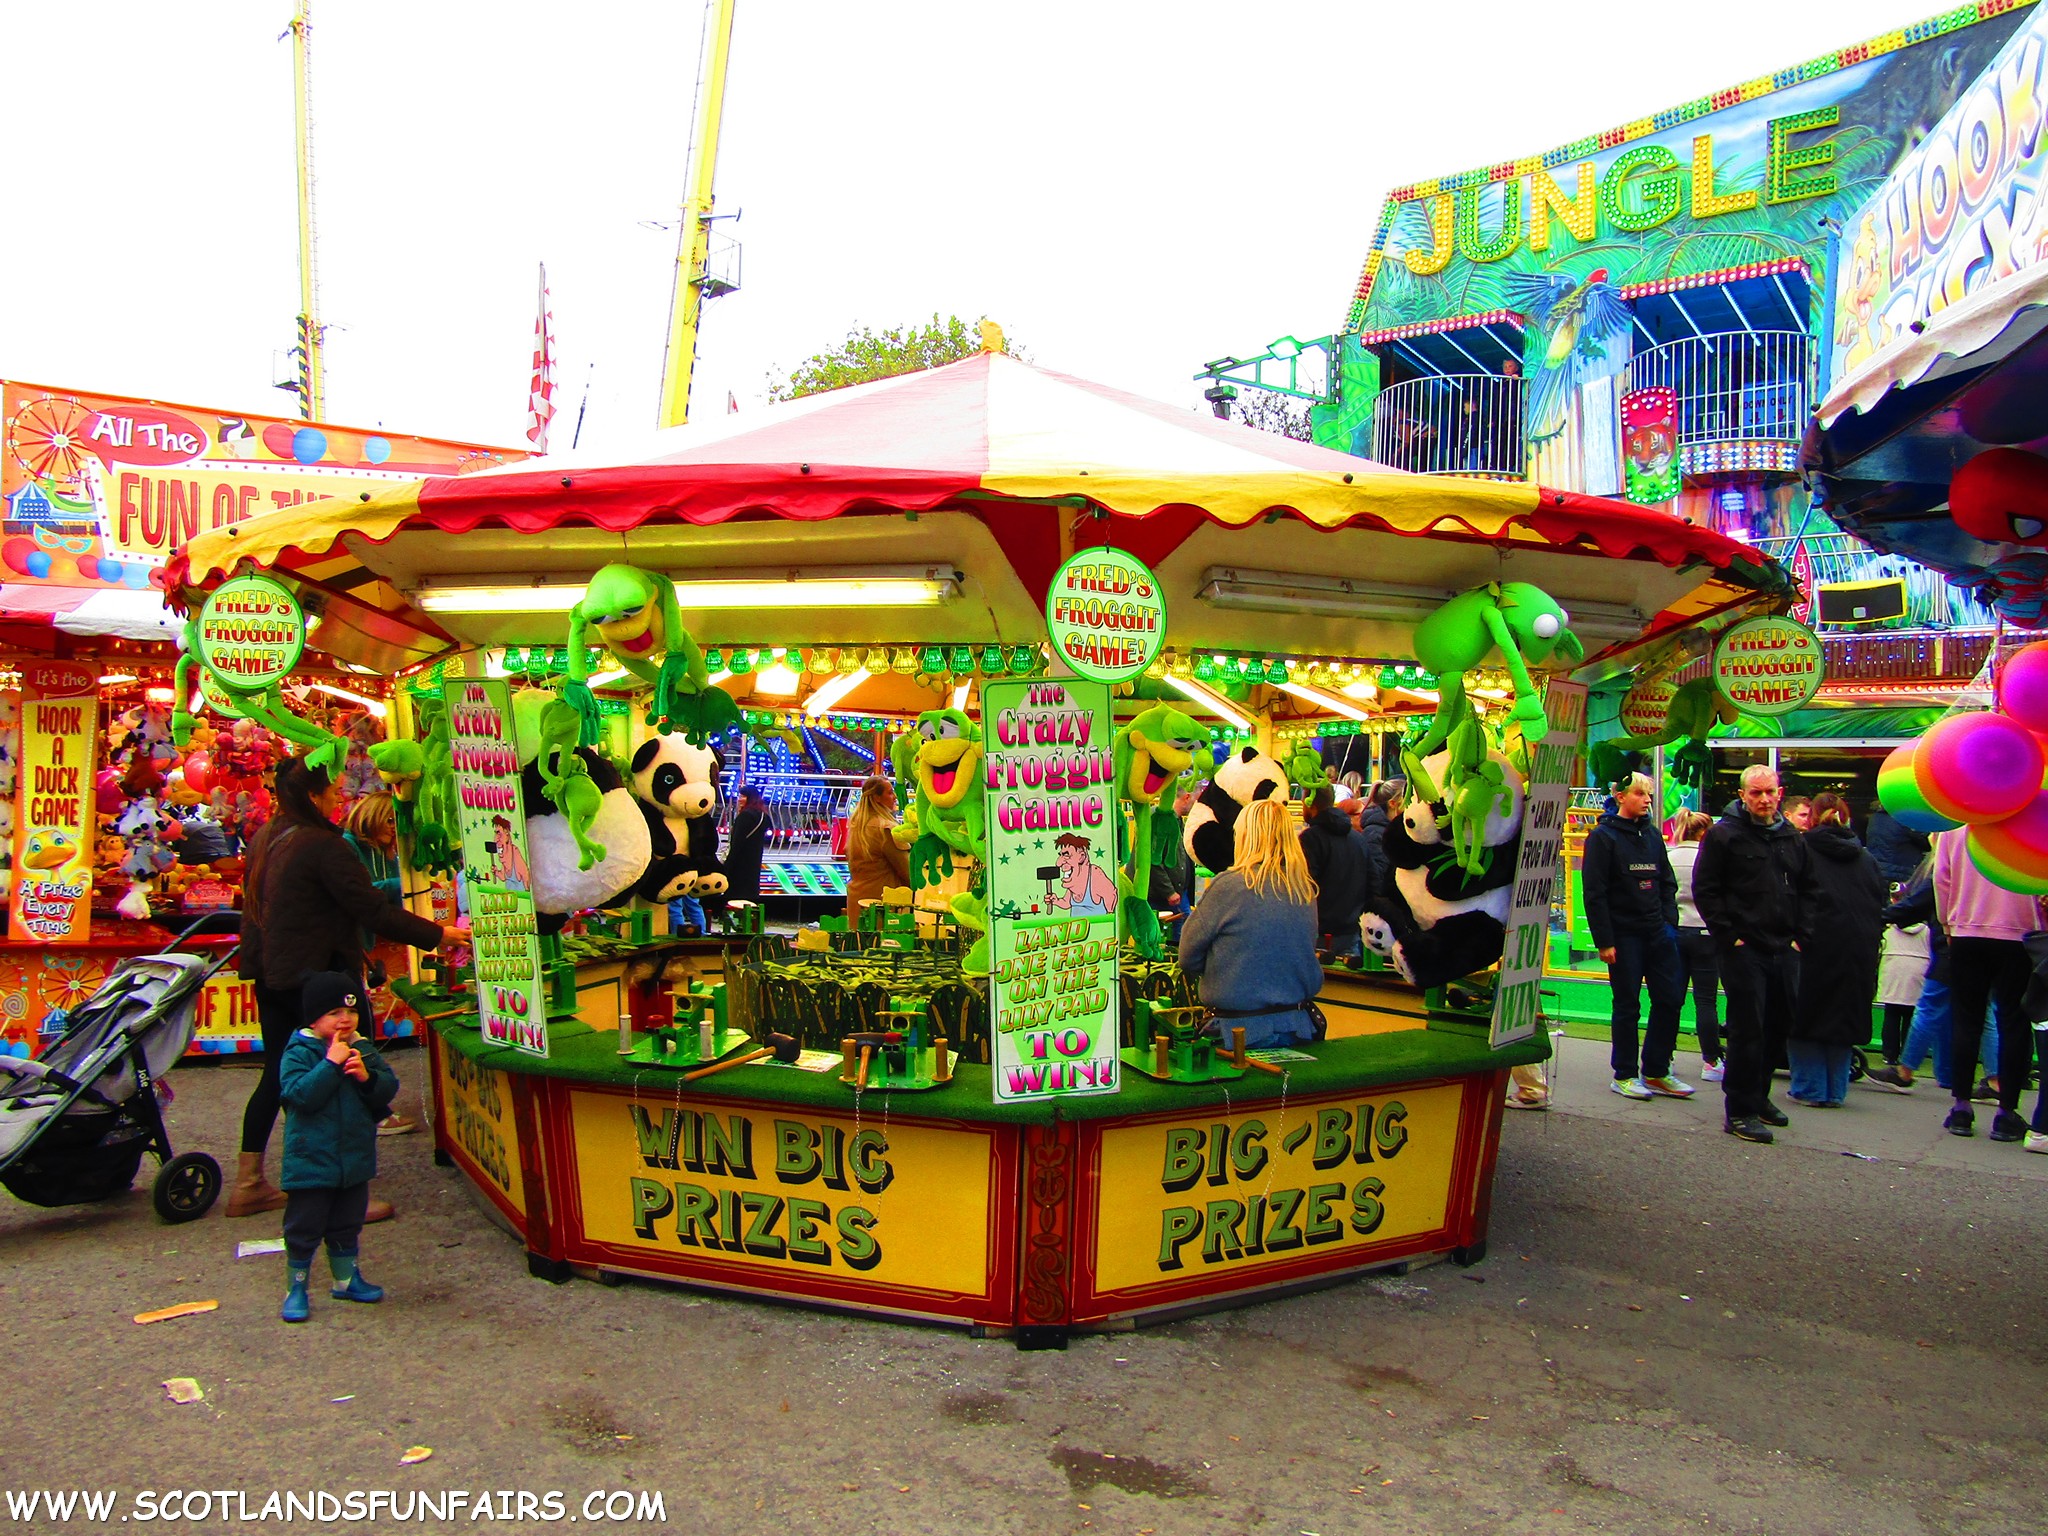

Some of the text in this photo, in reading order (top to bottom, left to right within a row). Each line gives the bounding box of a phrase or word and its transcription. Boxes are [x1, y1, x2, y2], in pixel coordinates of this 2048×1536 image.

[1404, 105, 1842, 275] JUNGLE
[90, 413, 200, 455] All The
[119, 472, 200, 549] FUN
[1066, 563, 1153, 599] FRED'S
[215, 590, 292, 616] FRED'S
[1055, 597, 1161, 632] FROGGIT
[204, 618, 298, 644] FROGGIT
[1729, 627, 1810, 652] FRED'S
[212, 647, 286, 676] GAME!
[1064, 632, 1148, 669] GAME!
[1720, 653, 1819, 678] FROGGIT
[35, 670, 87, 687] It's the
[465, 682, 485, 702] The
[1027, 682, 1065, 706] The
[1729, 679, 1807, 705] GAME!
[37, 704, 82, 736] HOOK
[453, 703, 501, 740] Crazy
[997, 707, 1094, 749] Crazy
[52, 737, 65, 766] A
[450, 739, 519, 777] Froggit
[985, 745, 1114, 791] Froggit
[35, 765, 79, 796] DUCK
[460, 775, 516, 811] Game
[31, 797, 79, 827] GAME
[997, 792, 1104, 832] Game
[1521, 840, 1542, 869] FROG
[1541, 840, 1554, 867] ON
[20, 880, 84, 898] A Prize
[480, 892, 518, 914] LAND
[1516, 878, 1551, 908] LILLY PAD
[25, 898, 74, 920] Every
[473, 913, 535, 938] ONE FROG
[481, 936, 528, 958] ON THE
[1015, 918, 1091, 953] LAND
[1514, 922, 1541, 971] TO
[478, 958, 535, 982] LILY PAD
[994, 937, 1119, 984] ONE FROG
[493, 985, 528, 1016] TO
[1009, 965, 1100, 1004] ON THE
[226, 984, 257, 1027] TH
[998, 987, 1110, 1034] LILY PAD
[1500, 979, 1539, 1033] WIN
[485, 1011, 544, 1050] WIN!
[1023, 1026, 1091, 1059] TO
[1003, 1056, 1113, 1093] WIN!
[628, 1103, 895, 1195] WIN BIG
[1160, 1118, 1268, 1194] BIG
[1313, 1100, 1409, 1170] BIG
[630, 1176, 882, 1271] PRIZES
[1158, 1176, 1385, 1271] PRIZES
